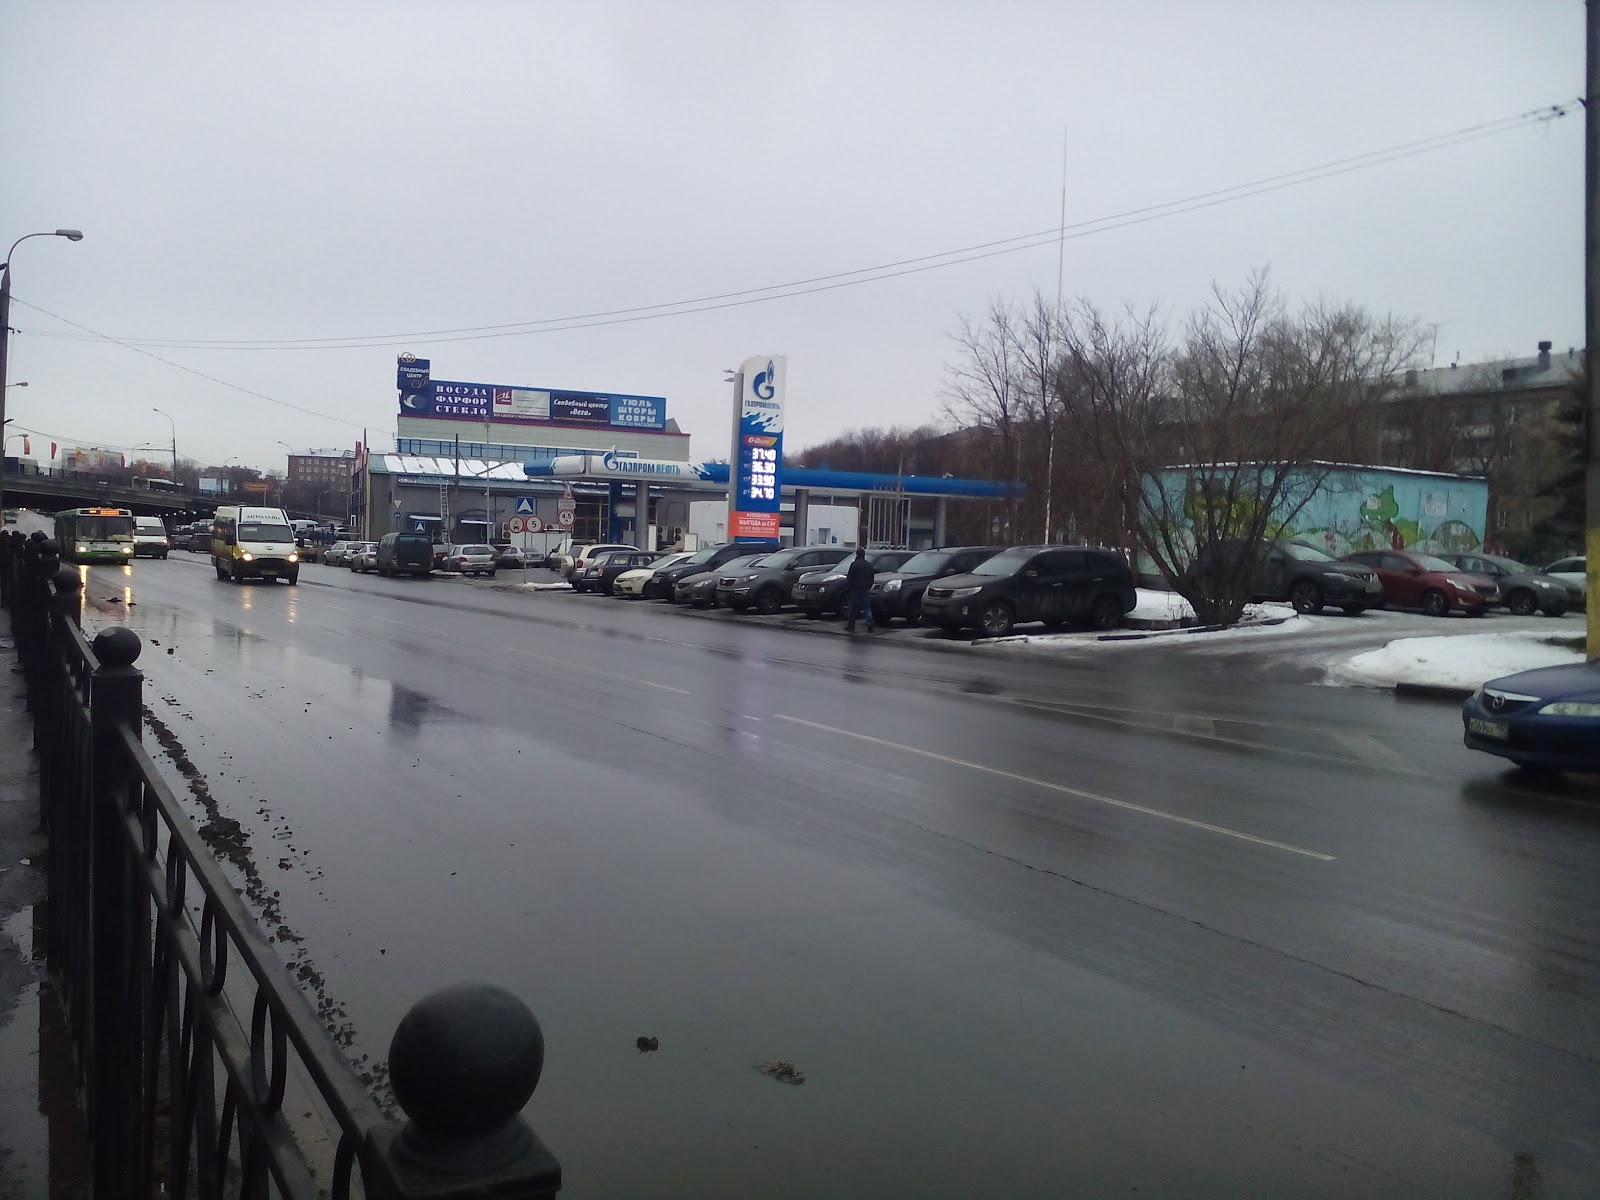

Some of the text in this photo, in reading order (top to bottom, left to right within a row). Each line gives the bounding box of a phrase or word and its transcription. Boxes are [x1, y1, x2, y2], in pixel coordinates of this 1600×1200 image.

[436, 385, 488, 396] ПОСУДА
[435, 396, 488, 406] ФАРФОР
[553, 398, 587, 408] Свадебный
[622, 398, 652, 407] ТЮЛЬ
[435, 405, 488, 415] СТЕКЛО
[618, 406, 656, 415] ШТОРЫ
[618, 414, 656, 423] КОВРЫ
[740, 519, 761, 527] ВЫГОДА
